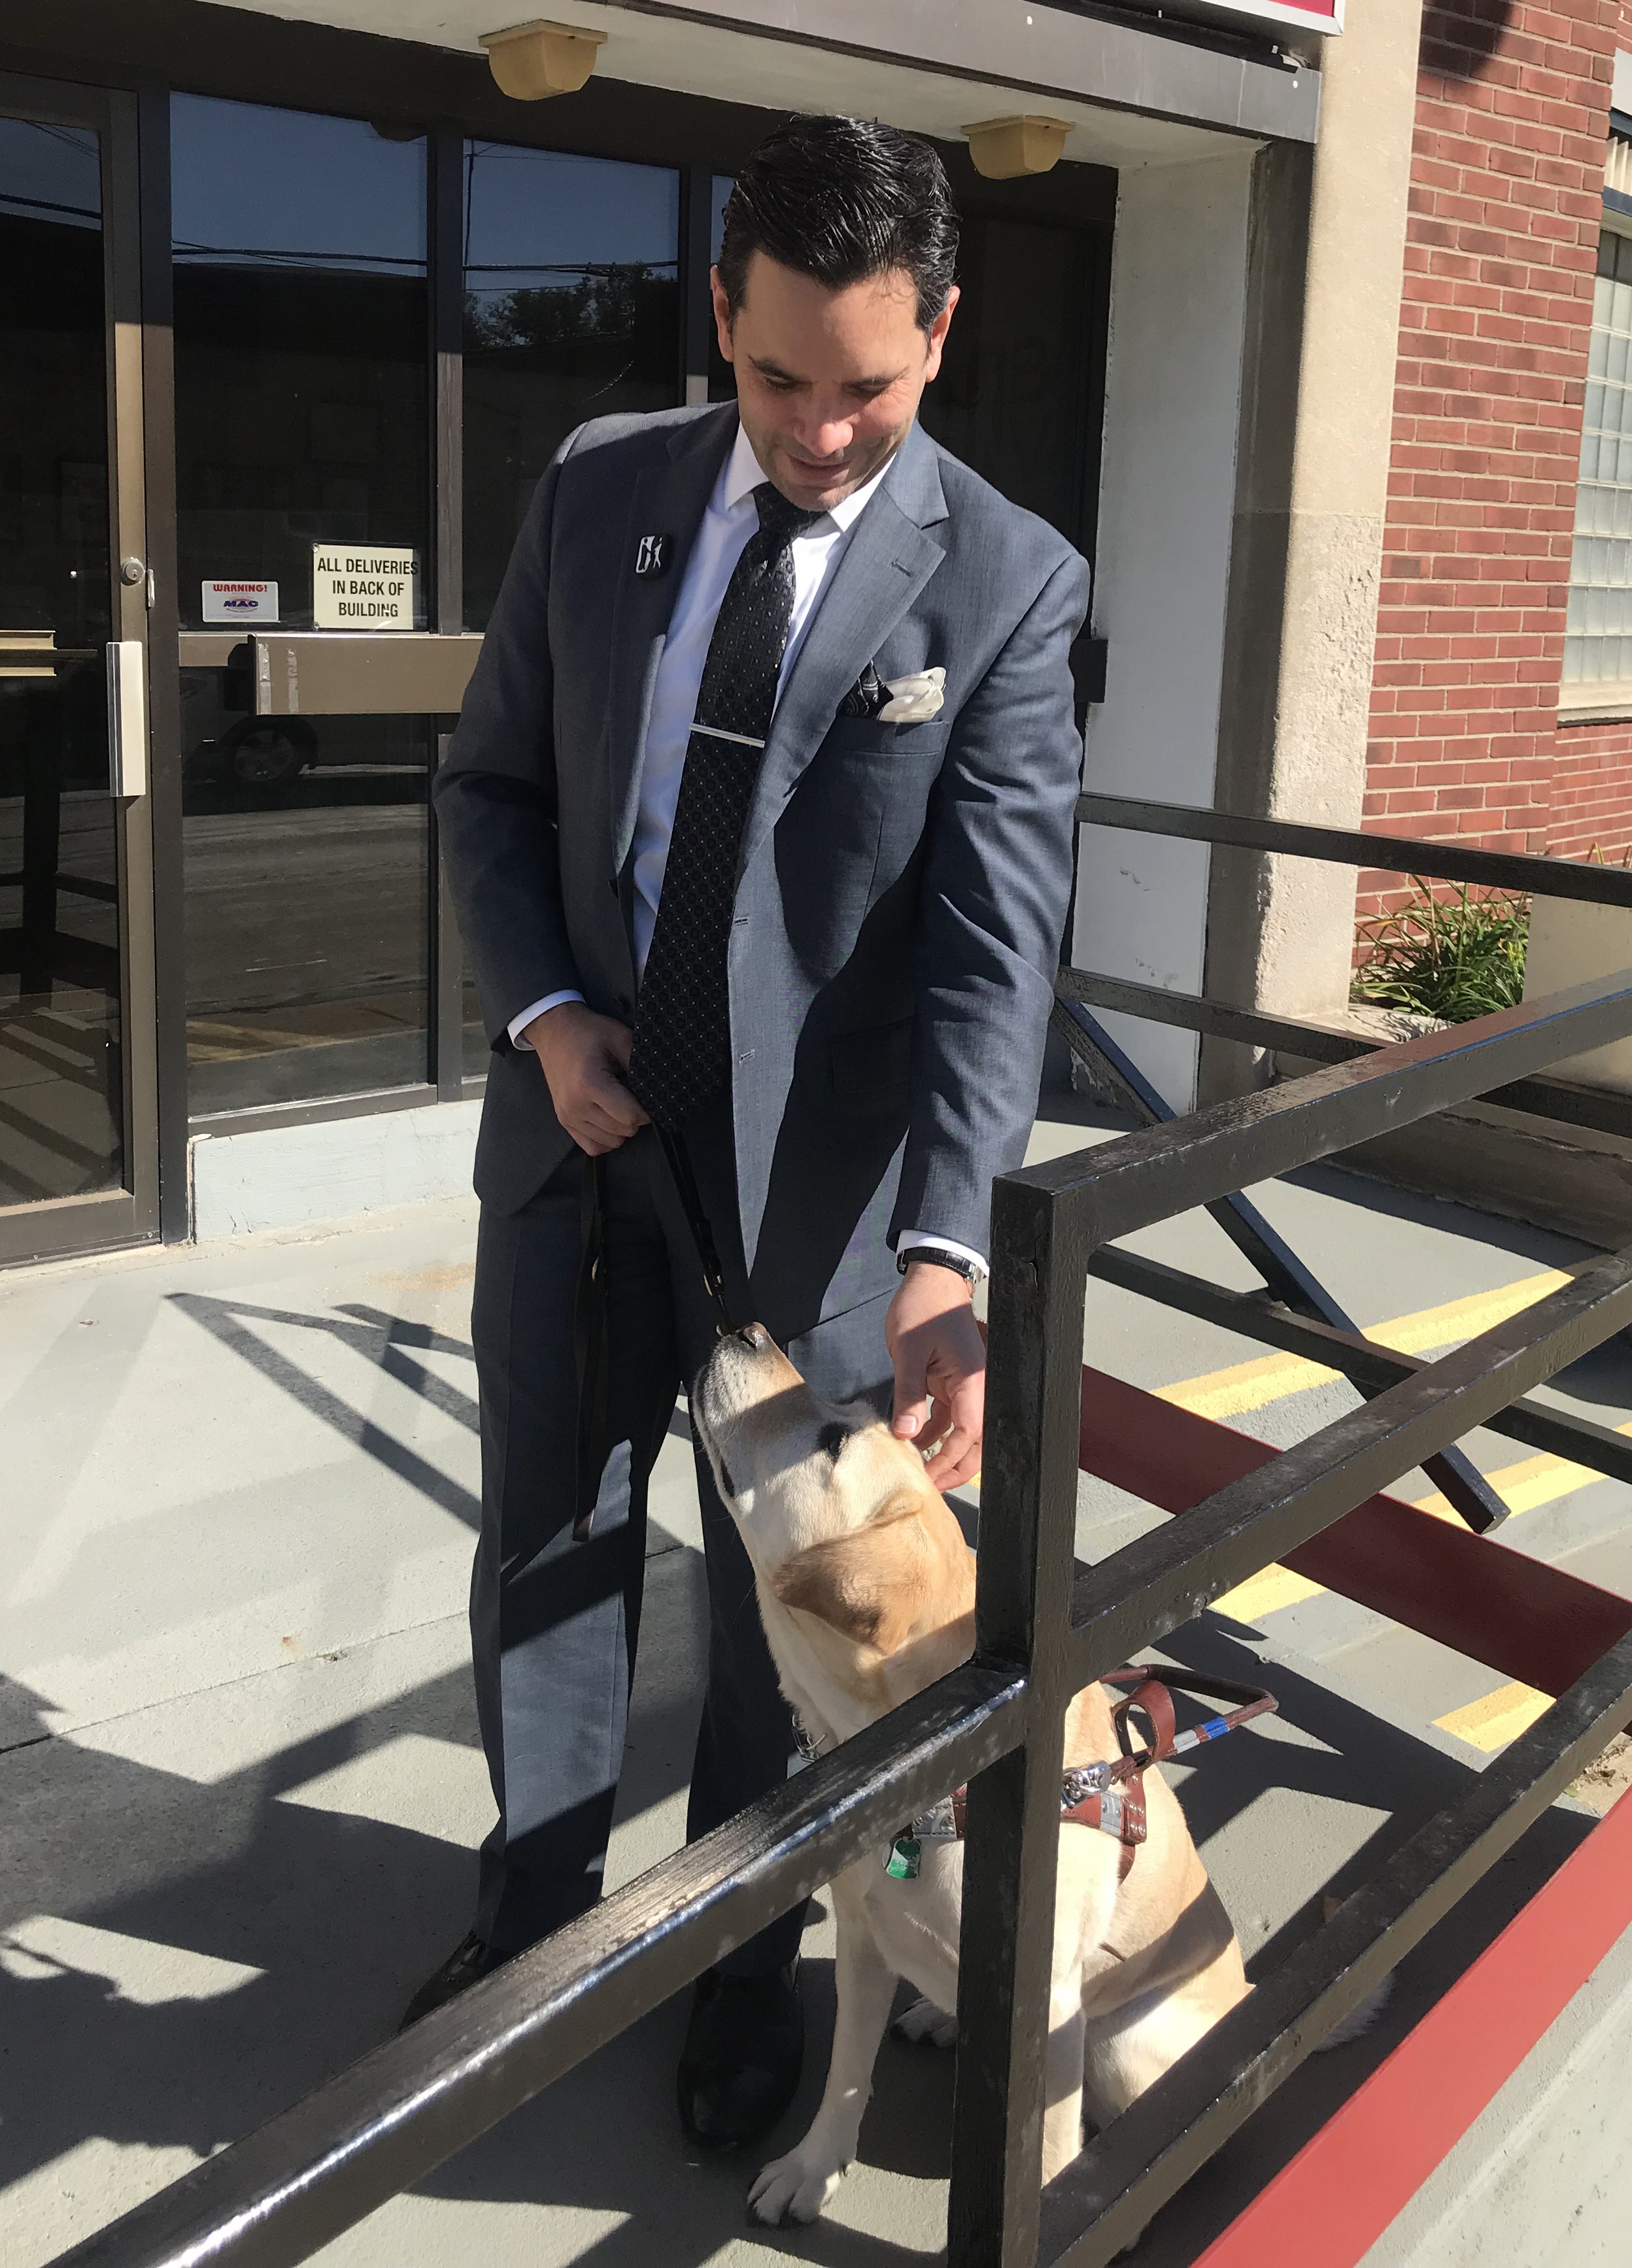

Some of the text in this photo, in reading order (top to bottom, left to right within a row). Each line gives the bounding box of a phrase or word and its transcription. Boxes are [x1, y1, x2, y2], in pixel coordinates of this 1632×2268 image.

[317, 557, 418, 576] ALL DELIVERIES
[212, 583, 267, 593] WARNING!
[333, 580, 405, 596] IN BACK OF
[339, 602, 398, 617] BUILDING
